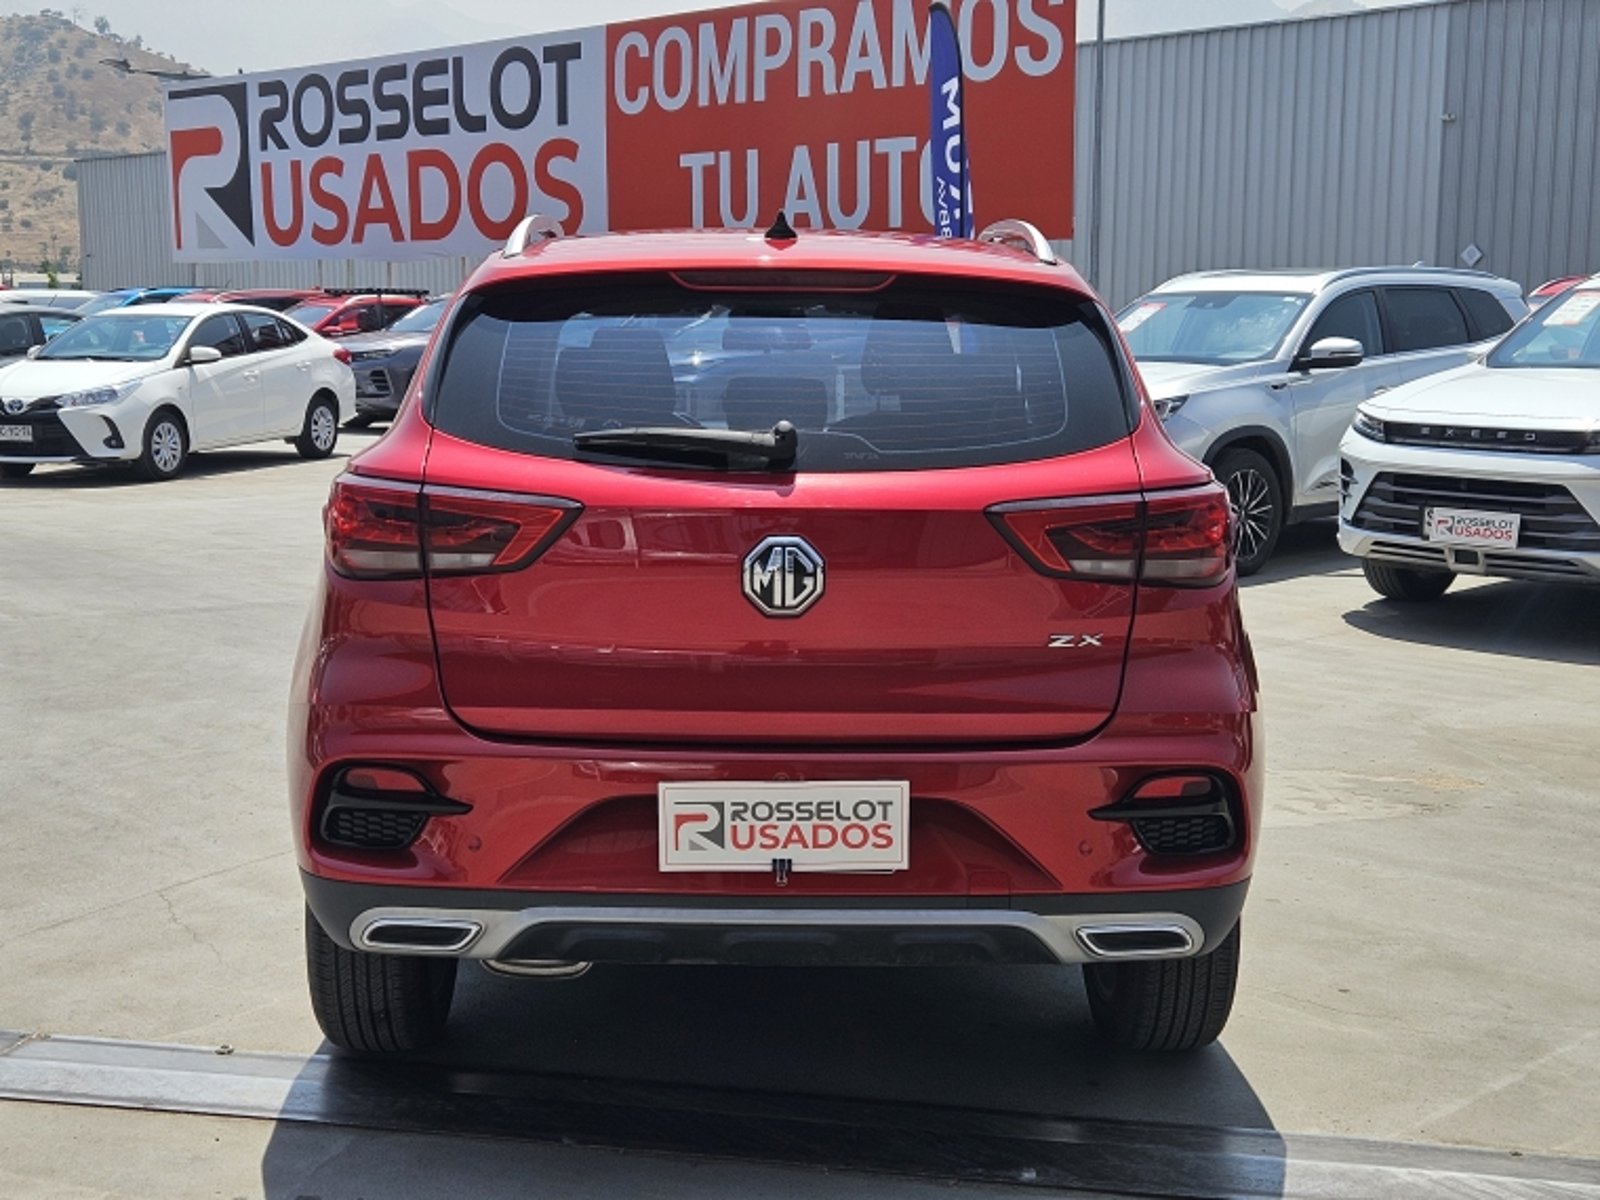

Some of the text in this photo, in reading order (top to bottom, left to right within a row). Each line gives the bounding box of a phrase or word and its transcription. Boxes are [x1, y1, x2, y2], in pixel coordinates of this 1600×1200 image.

[614, 0, 1064, 115] COMPRAMOS
[258, 42, 582, 152] ROSSELOT
[260, 138, 584, 247] USADOS
[680, 149, 759, 229] TU
[1420, 426, 1536, 441] EXEED
[1454, 525, 1513, 541] USADOS
[1456, 516, 1514, 529] ROSSELOT
[750, 544, 817, 610] MG
[1048, 633, 1104, 648] ZX
[730, 800, 894, 822] ROSSELOT
[730, 823, 895, 850] USADOS
